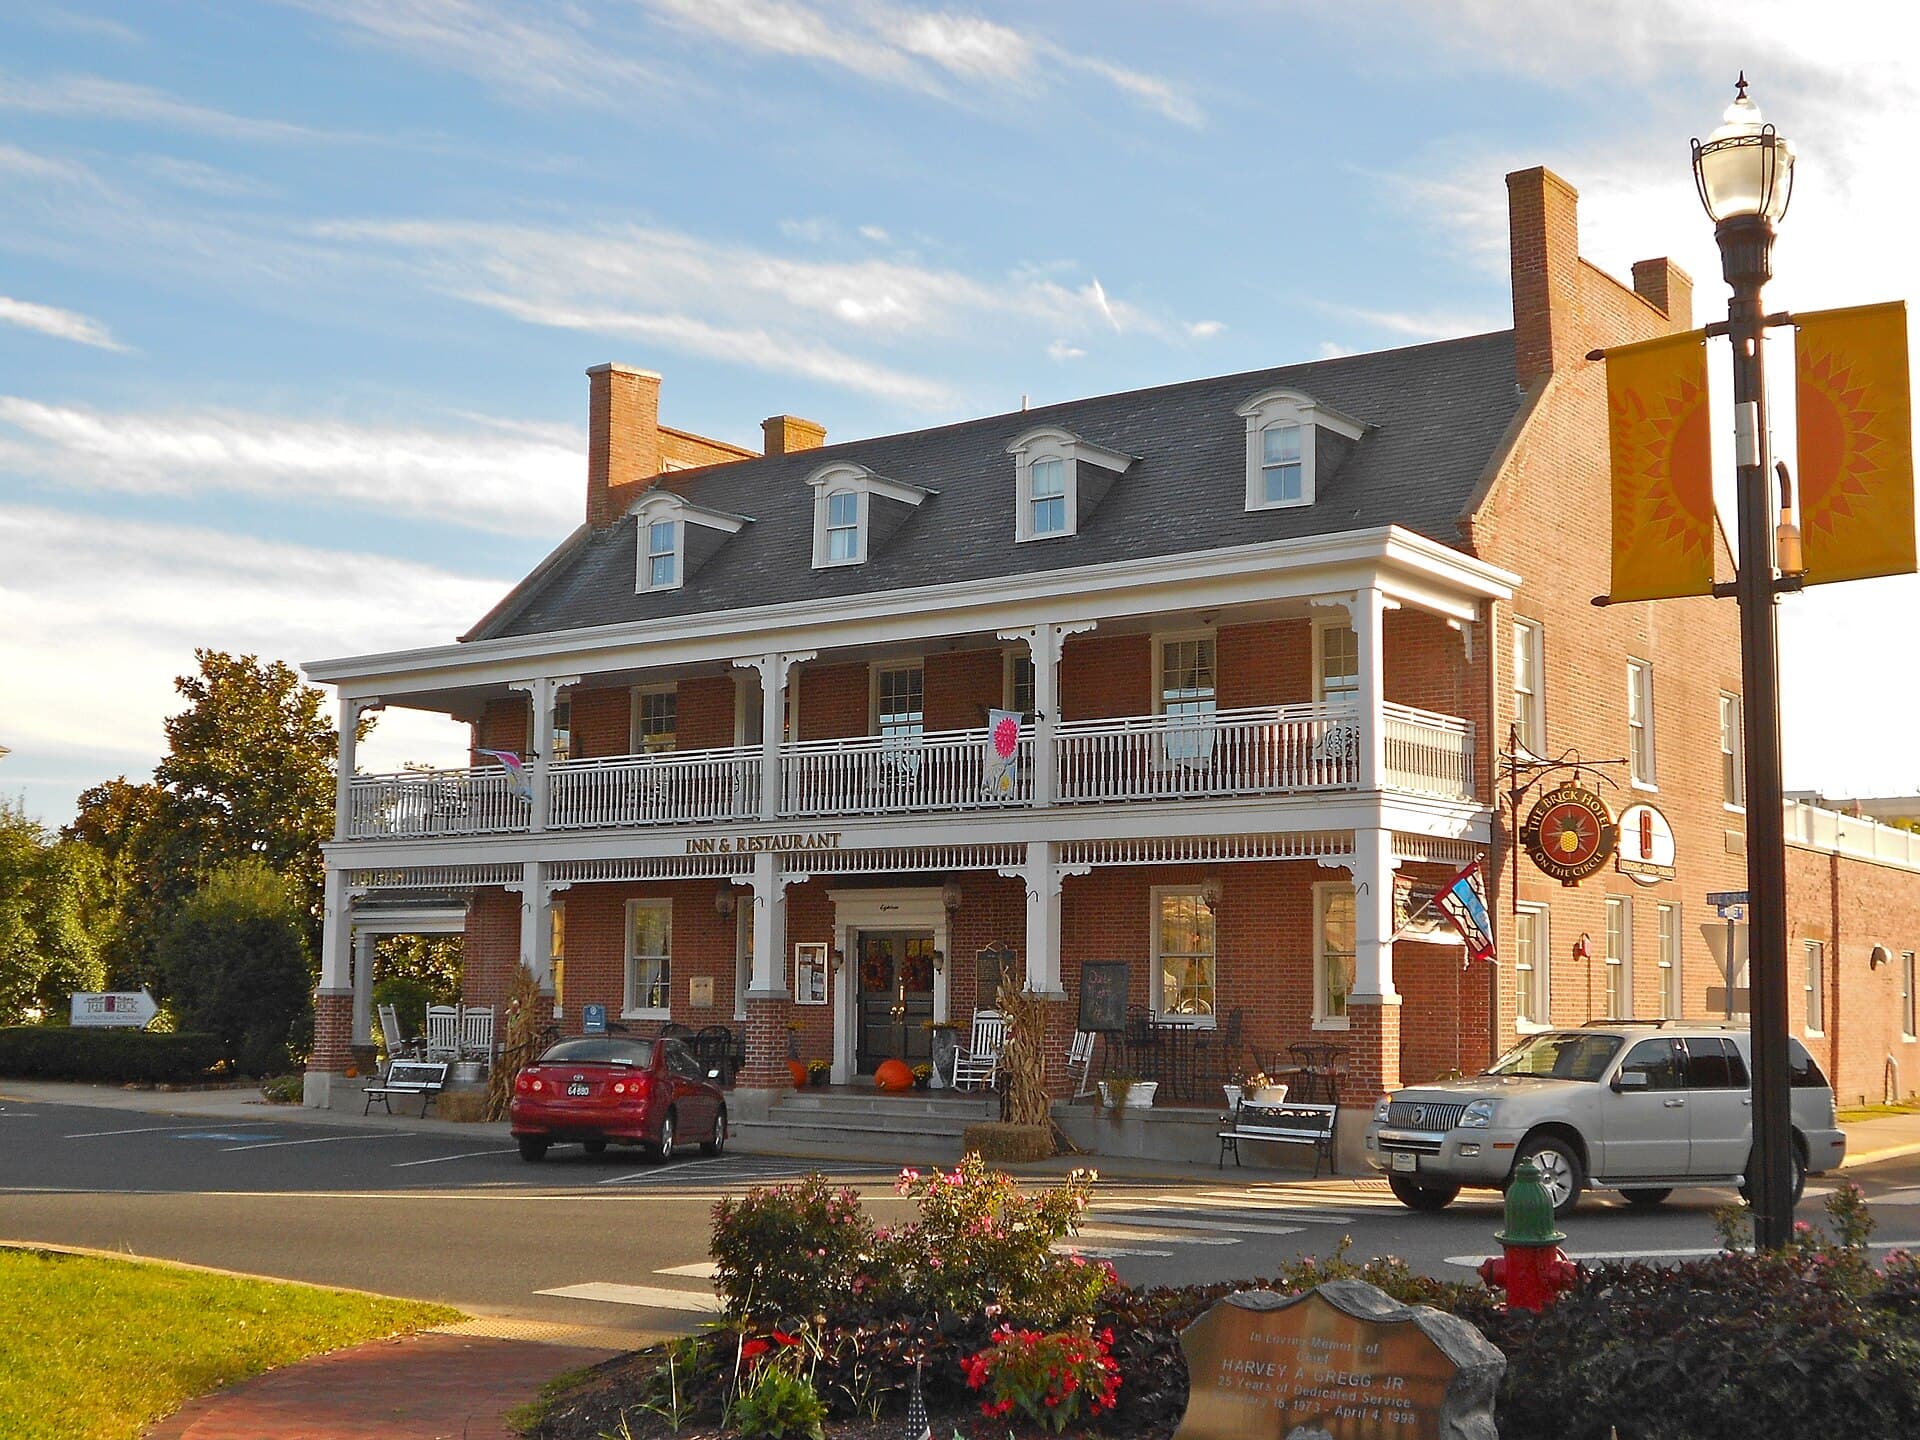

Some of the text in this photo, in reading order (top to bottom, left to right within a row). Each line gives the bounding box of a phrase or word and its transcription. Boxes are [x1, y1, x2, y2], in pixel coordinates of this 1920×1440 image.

[1611, 386, 1649, 552] Summer
[1528, 790, 1610, 833] THE BRICK HOTEL
[686, 832, 842, 854] INN & RESTAURANT
[1535, 852, 1550, 868] ON
[1550, 864, 1570, 877] THE
[1572, 852, 1604, 876] CIRCLE
[1366, 1343, 1379, 1355] of
[1222, 1359, 1287, 1378] HARVEY
[1217, 1375, 1411, 1409] 25 Years of Dedicated Service
[1294, 1400, 1321, 1414] 1973
[1335, 1404, 1367, 1420] April
